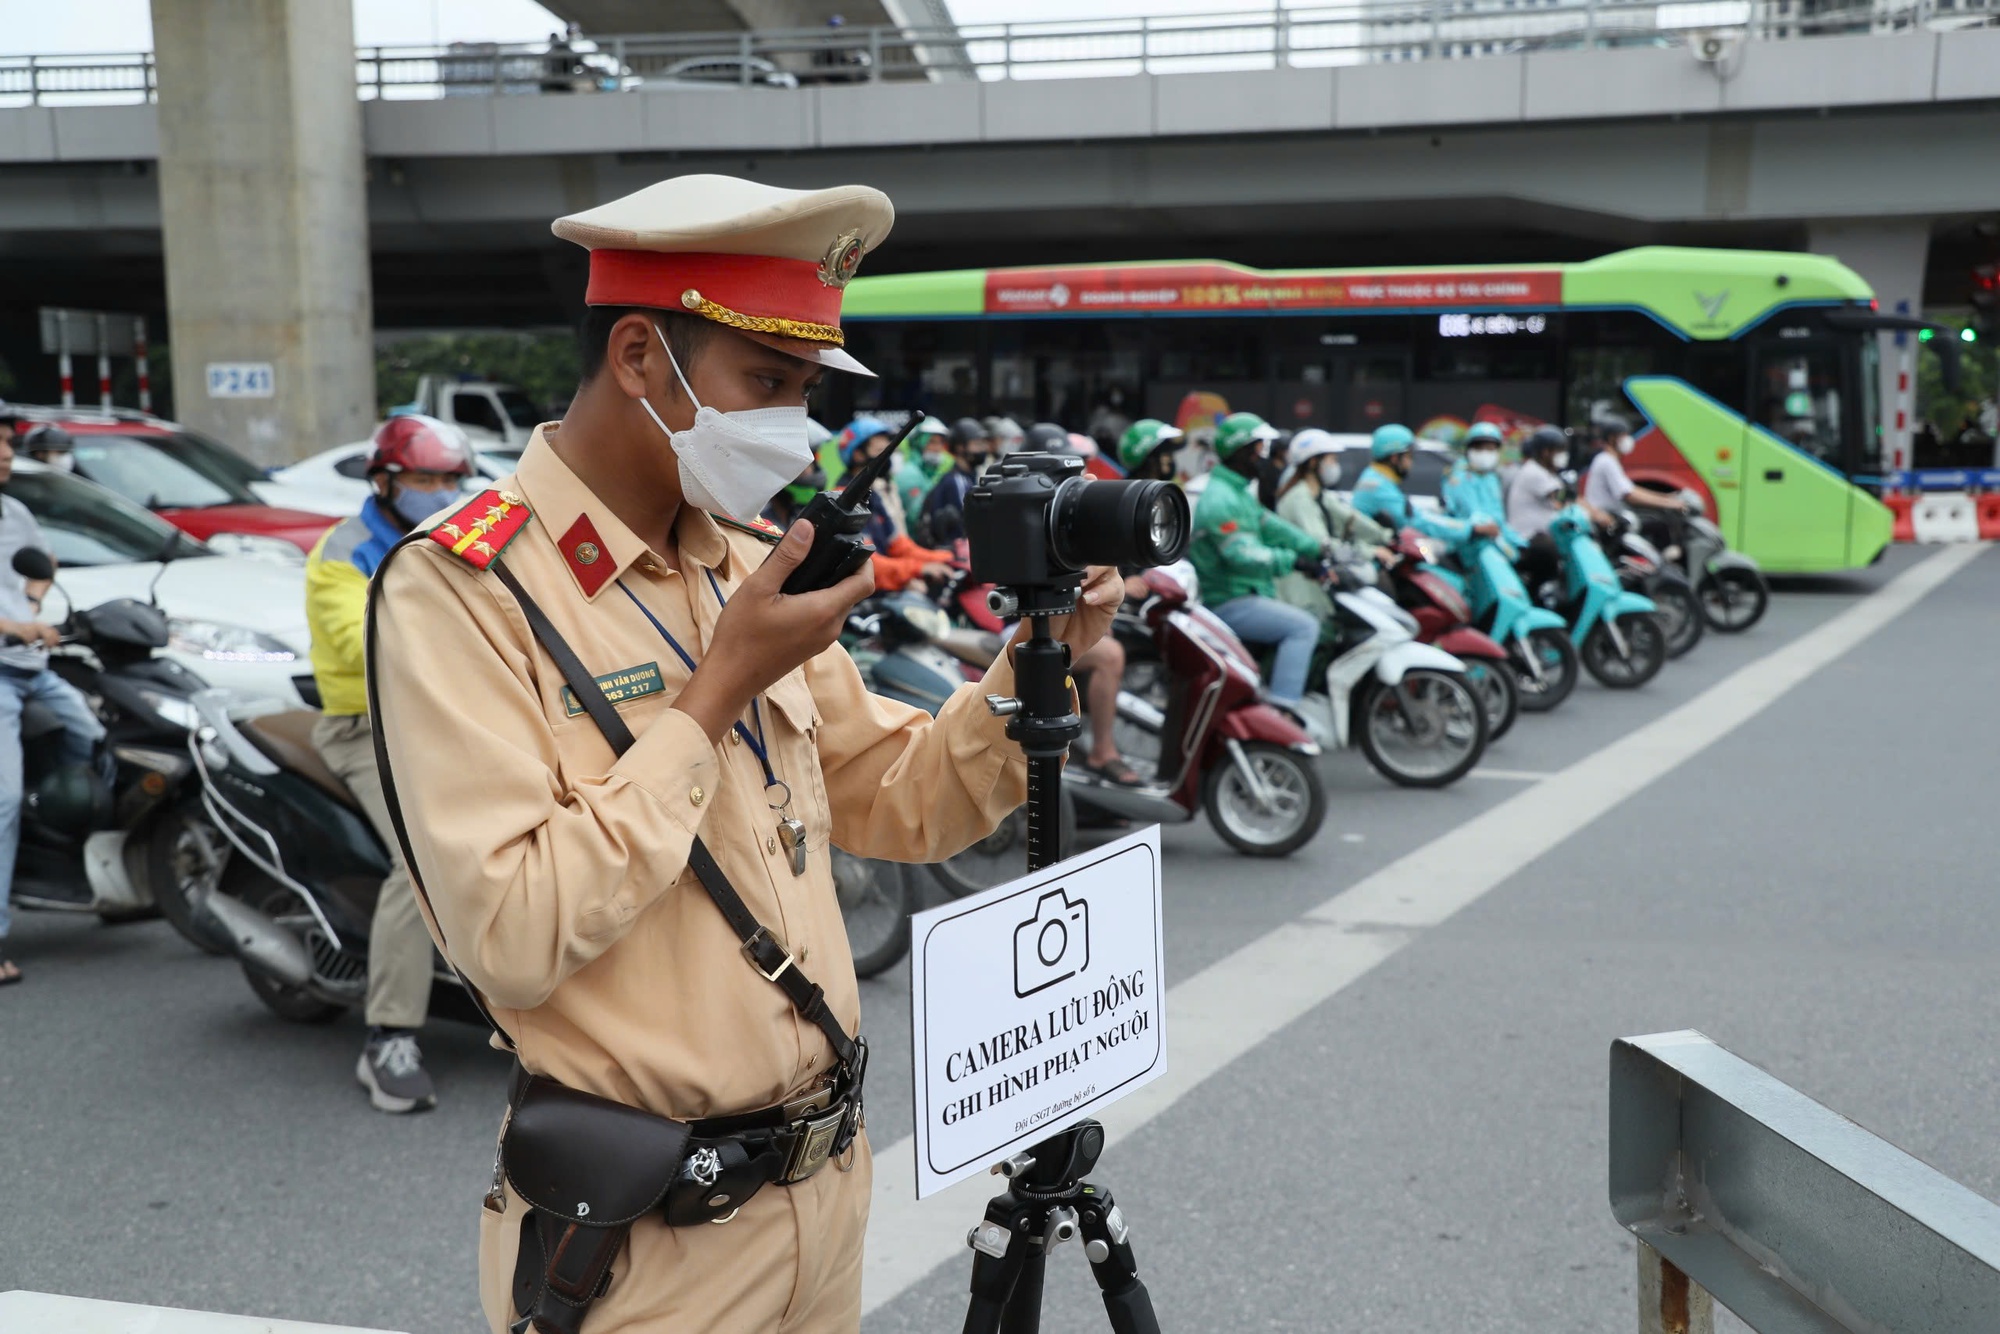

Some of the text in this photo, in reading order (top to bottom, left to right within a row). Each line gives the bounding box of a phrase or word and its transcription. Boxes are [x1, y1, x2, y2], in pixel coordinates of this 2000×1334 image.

[209, 369, 269, 391] P241
[631, 682, 649, 694] 217
[946, 969, 1144, 1083] CAMERA LƯU ĐỘNG
[942, 1009, 1149, 1126] GHI HÌNH PHẠT NGUỘI
[1015, 1083, 1096, 1132] Đội CSGT đường bộ số 6
